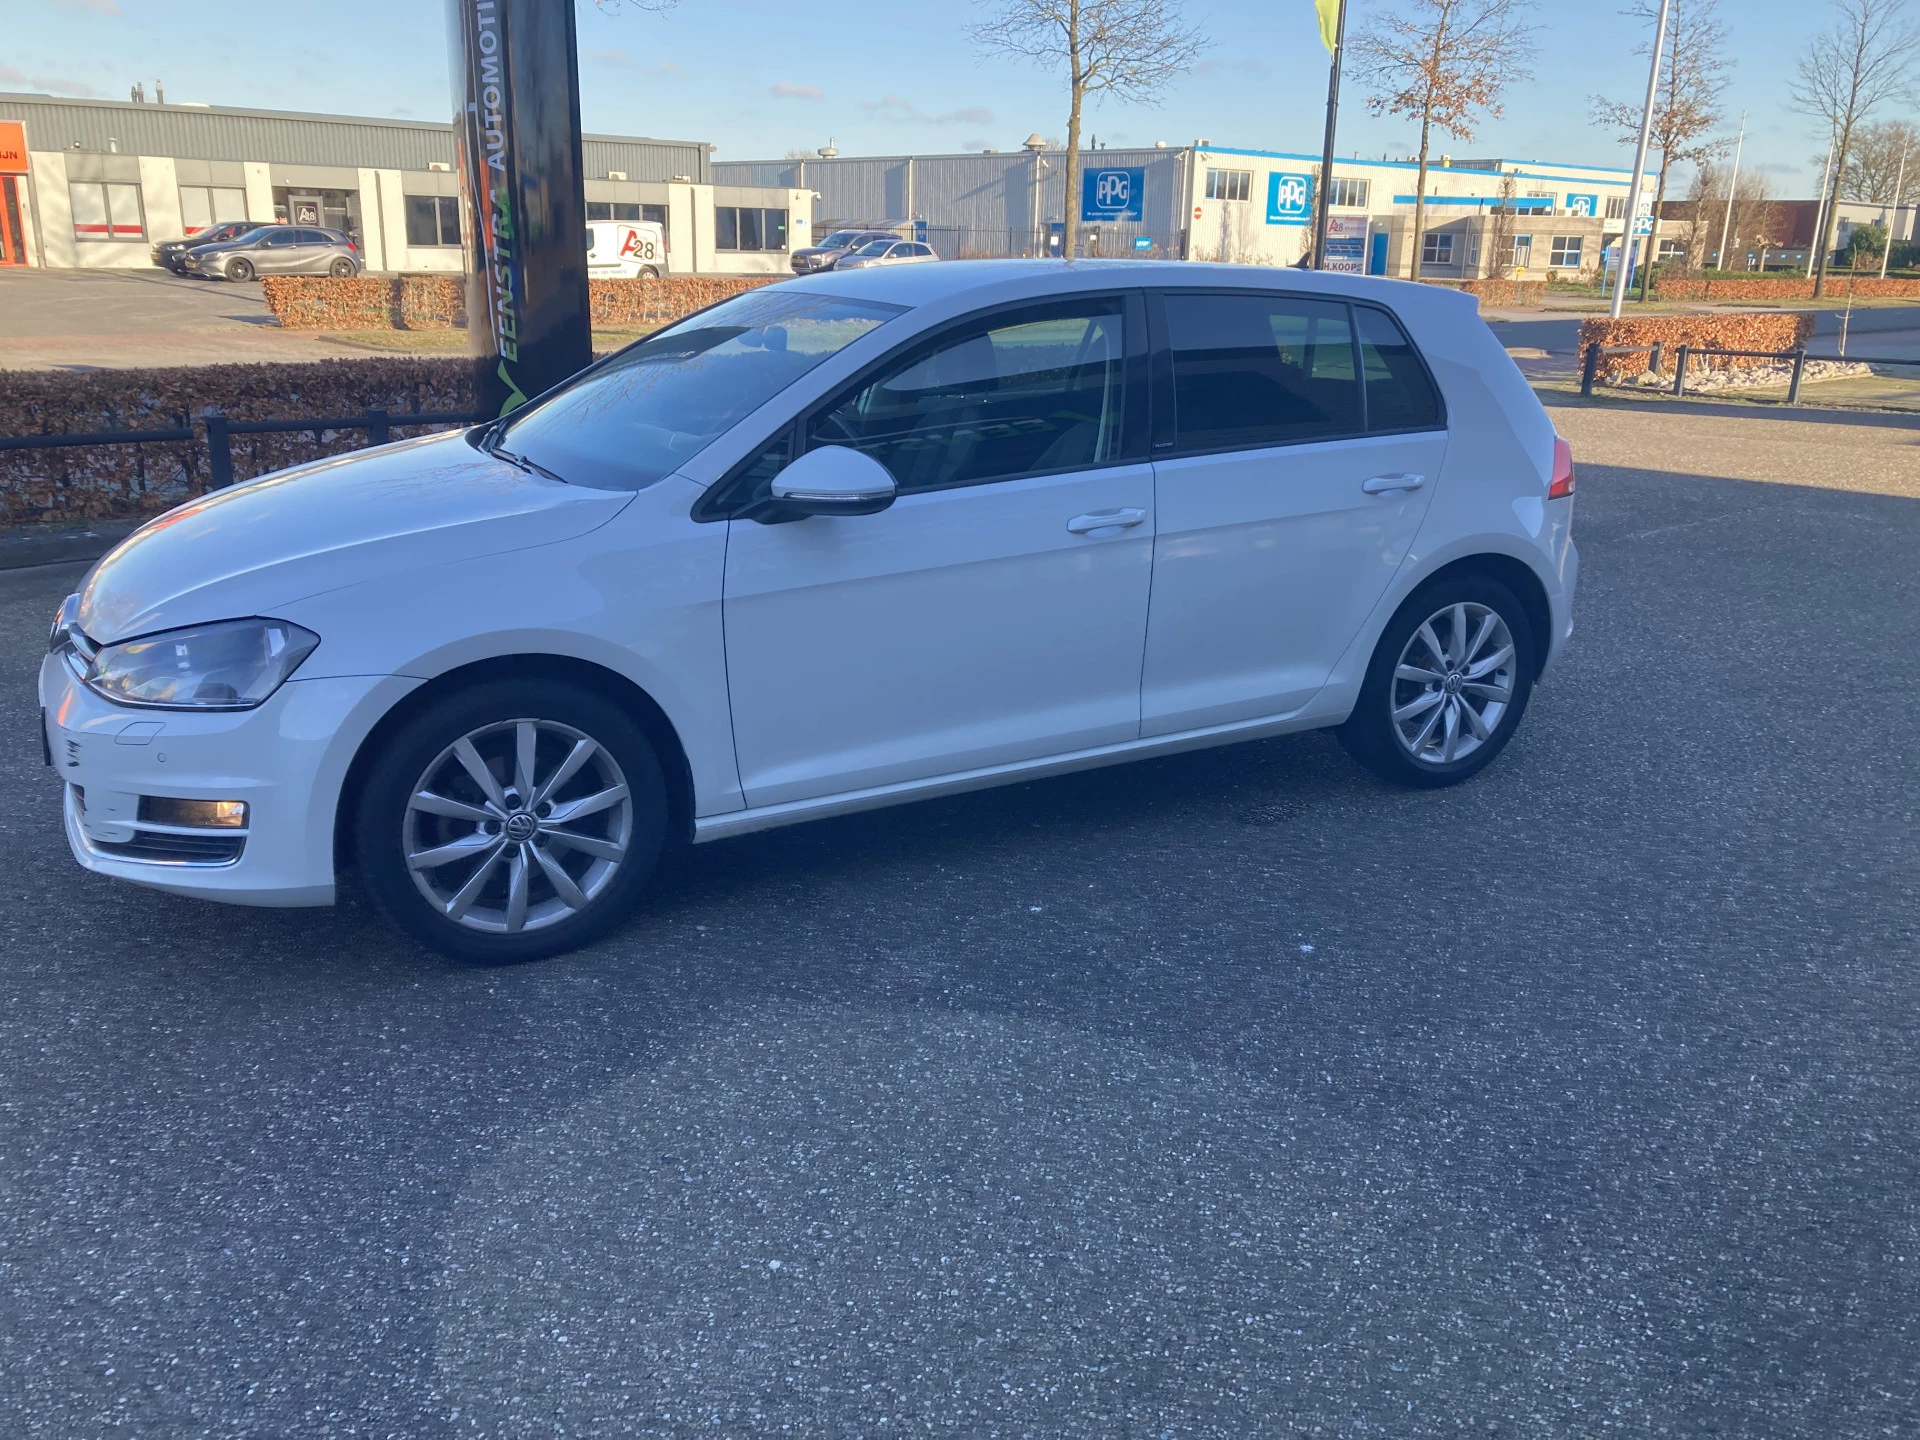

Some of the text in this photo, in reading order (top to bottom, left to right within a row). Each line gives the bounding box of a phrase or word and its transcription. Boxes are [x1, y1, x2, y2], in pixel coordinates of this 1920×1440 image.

[476, 0, 506, 172] AUTOMOTI
[1098, 175, 1128, 205] PPG
[1280, 181, 1305, 210] PPG
[300, 207, 315, 222] A28
[1328, 218, 1344, 233] A28
[620, 229, 655, 260] A28
